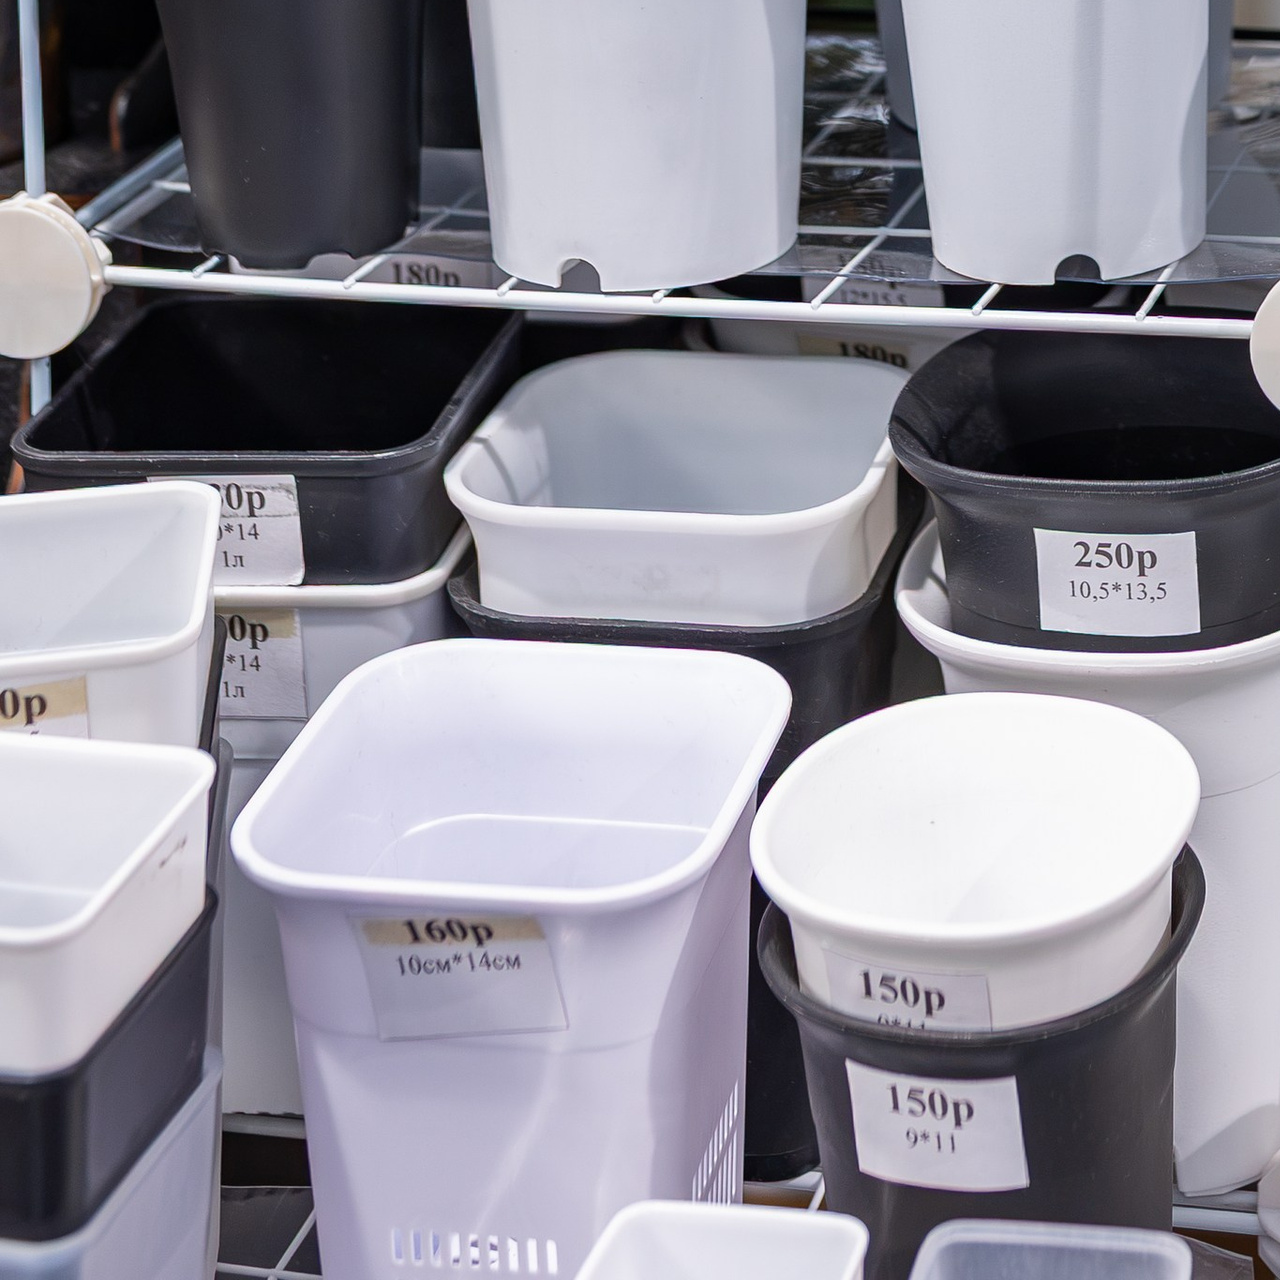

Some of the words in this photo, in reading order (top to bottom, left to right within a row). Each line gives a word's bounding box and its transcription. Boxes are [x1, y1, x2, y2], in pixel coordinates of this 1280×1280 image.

[208, 482, 266, 518] 0р
[1073, 541, 1158, 577] 250р
[229, 614, 269, 650] 0р
[0, 688, 48, 727] 0р
[403, 919, 494, 948] 160р
[858, 969, 946, 1018] 150р
[888, 1082, 975, 1129] 150р
